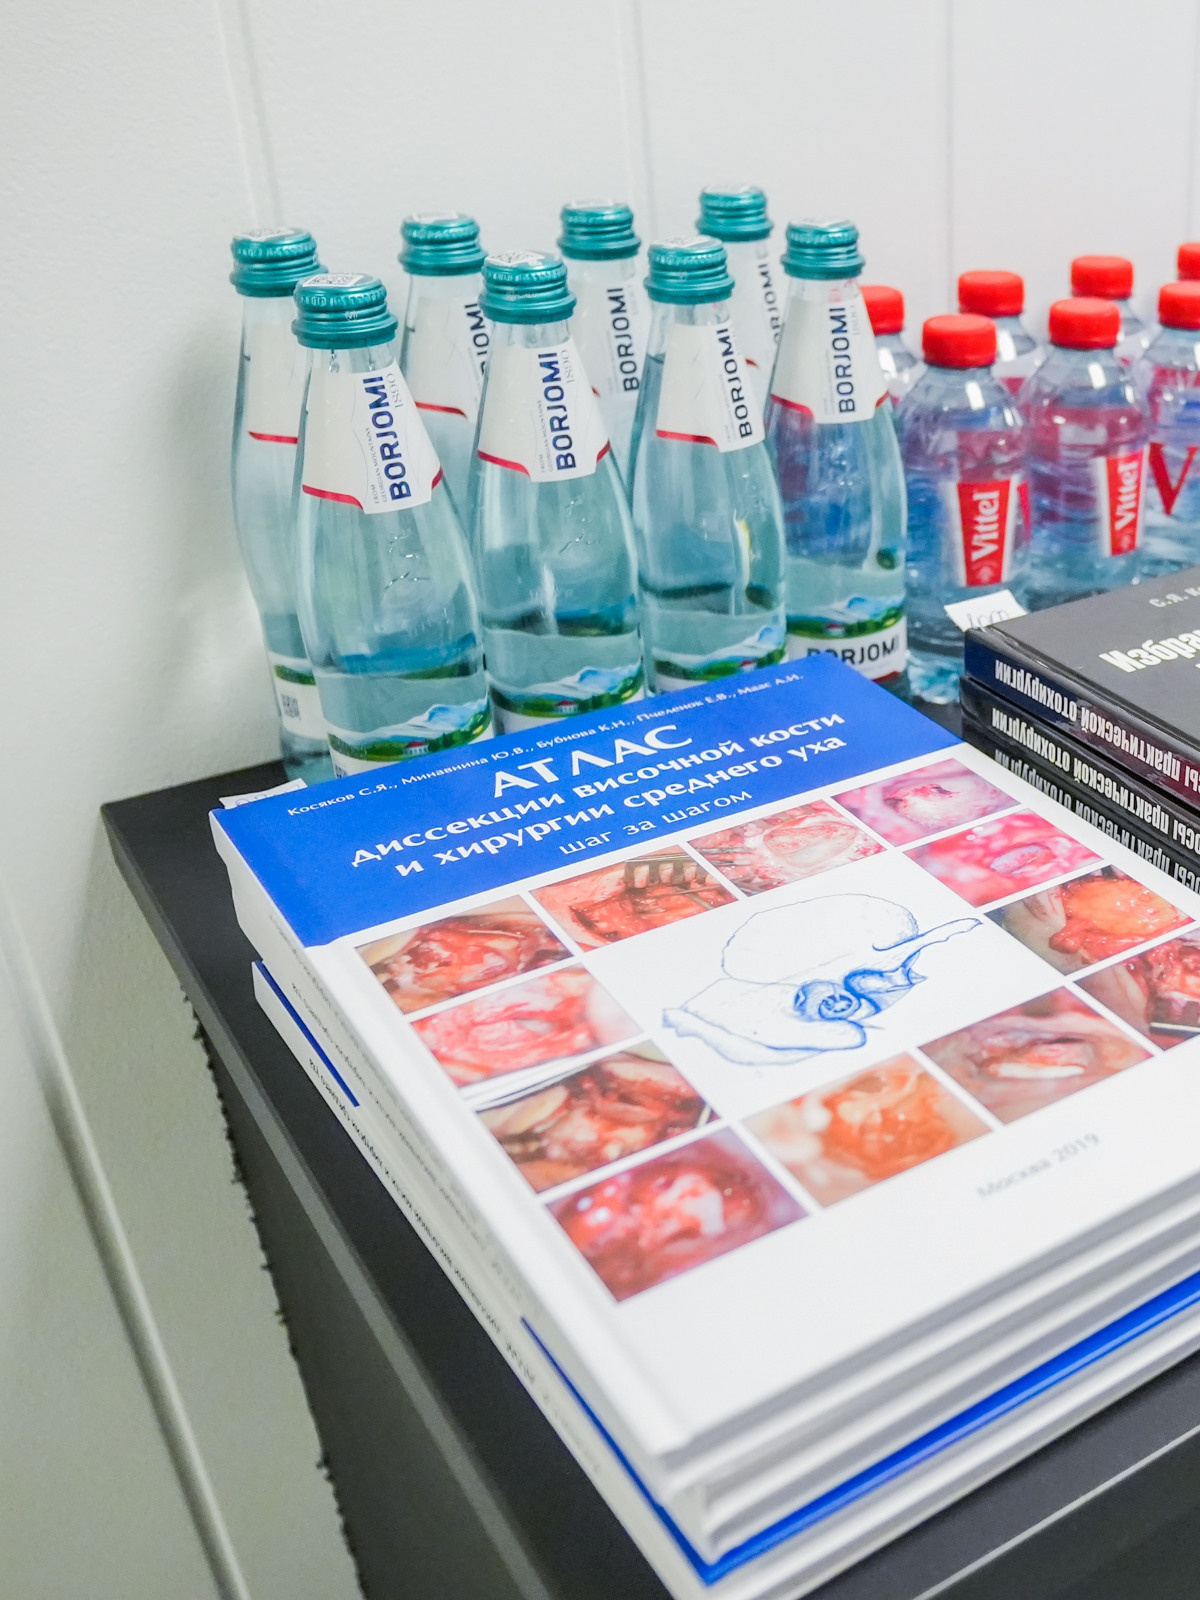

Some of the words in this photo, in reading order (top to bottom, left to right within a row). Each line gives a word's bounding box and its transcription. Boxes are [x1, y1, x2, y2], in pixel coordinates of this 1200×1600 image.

[607, 287, 640, 392] BORJOMI
[829, 306, 856, 413] BORJOMI
[386, 373, 404, 409] 1890
[537, 352, 577, 471] BORJOMI
[716, 327, 753, 439] BORJOMI
[362, 376, 412, 501] BORJOMI
[370, 484, 380, 505] FROM
[970, 489, 1001, 563] Vittel
[1114, 460, 1139, 531] Vittel
[1149, 592, 1188, 609] С.Я.
[994, 659, 1078, 722] отохирургии
[287, 792, 356, 816] Косяков
[358, 782, 398, 797] С.Я.,
[401, 756, 489, 785] Минавнина
[491, 745, 534, 762] Ю.В.,
[536, 728, 597, 750] Бубнова
[493, 724, 693, 799] АТЛАС
[991, 707, 1071, 772] отохирургии
[1081, 706, 1182, 782] практической
[351, 793, 566, 868] диссекции
[572, 740, 745, 798] височной
[749, 712, 846, 748] кости
[395, 859, 425, 877] и
[432, 804, 615, 866] хирургии
[623, 754, 783, 808] среднего
[787, 736, 848, 763] уха
[558, 830, 612, 855] шаг
[622, 819, 657, 836] за
[661, 790, 753, 825] шагом
[1073, 757, 1170, 835] практической
[1051, 1132, 1100, 1163] 2019
